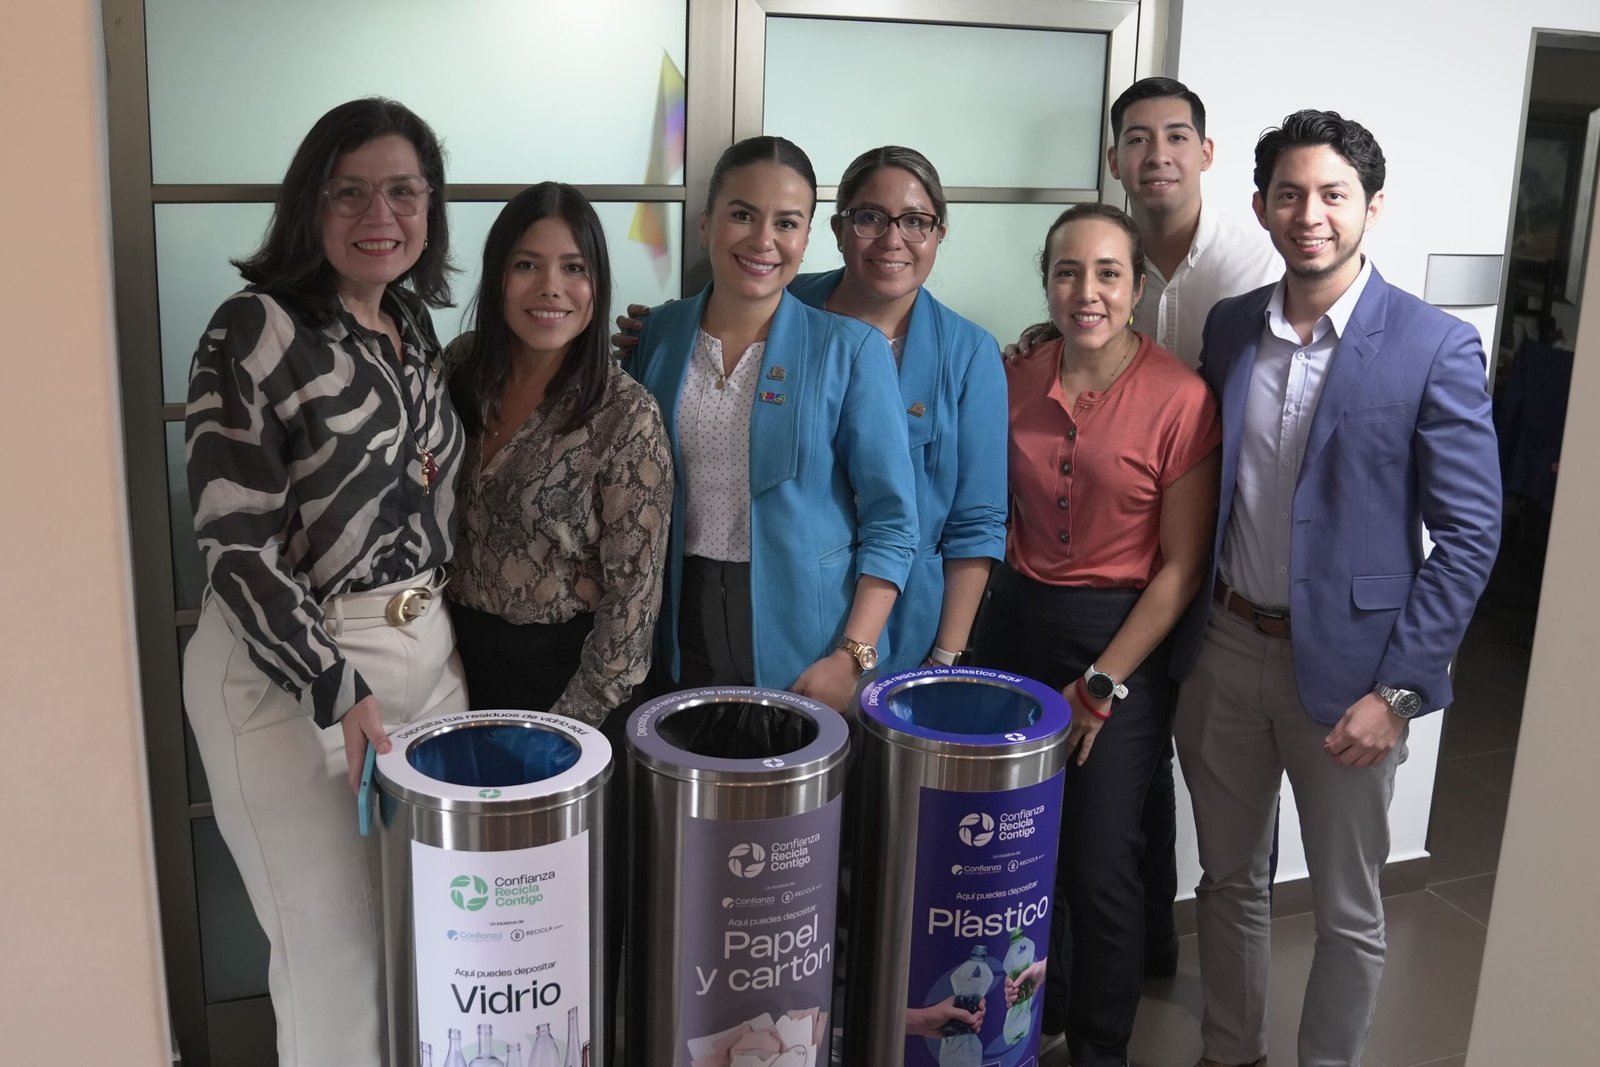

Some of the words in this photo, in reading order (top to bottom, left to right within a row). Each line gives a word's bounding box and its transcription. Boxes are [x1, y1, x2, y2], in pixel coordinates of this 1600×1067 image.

[868, 686, 883, 706] Deposita
[880, 679, 894, 690] tus
[891, 670, 934, 682] residuos
[637, 713, 651, 737] Deposita
[644, 706, 660, 715] tus
[658, 692, 699, 707] residuos
[397, 720, 442, 739] Deposita
[540, 716, 569, 727] vidrio
[999, 804, 1045, 823] Confianza
[999, 817, 1034, 832] Recicla
[771, 832, 821, 853] Confianza
[998, 826, 1036, 842] Contigo
[770, 846, 808, 862] Recicla
[1020, 855, 1038, 866] RECICLA
[770, 855, 811, 872] Contigo
[963, 864, 1002, 872] Confianza
[494, 870, 556, 887] Confianza
[494, 884, 540, 897] Recicla
[794, 886, 816, 897] RECICLA
[976, 889, 1007, 901] puedes
[1007, 880, 1039, 896] depositar
[495, 893, 544, 907] Contigo
[735, 896, 775, 905] Confianza
[750, 915, 782, 927] puedes
[783, 904, 817, 921] depositar
[928, 895, 1049, 938] Plástico
[460, 931, 502, 939] Confianza
[526, 926, 553, 936] RECICLA
[724, 913, 818, 962] Papel
[477, 969, 513, 978] puedes
[514, 960, 558, 975] depositar
[696, 966, 718, 996] y
[728, 942, 831, 991] cartón
[451, 980, 562, 1015] Vidrio
